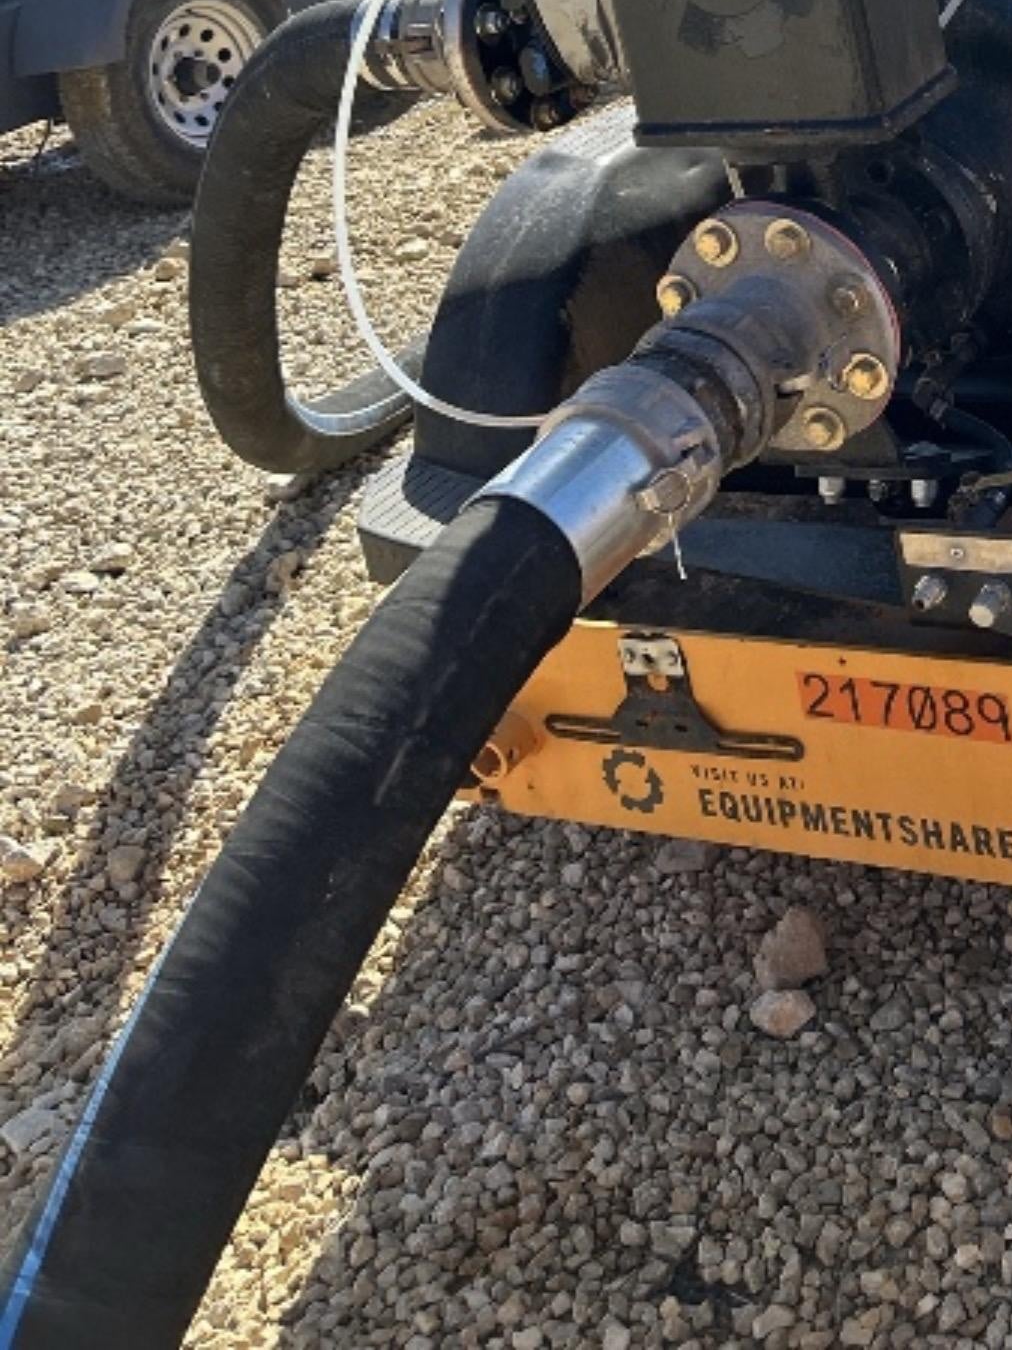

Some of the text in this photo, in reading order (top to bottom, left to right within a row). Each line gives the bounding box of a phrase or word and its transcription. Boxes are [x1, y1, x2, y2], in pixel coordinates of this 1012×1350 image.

[801, 672, 1012, 742] 217089
[690, 764, 739, 783] VISIT
[746, 771, 769, 788] US
